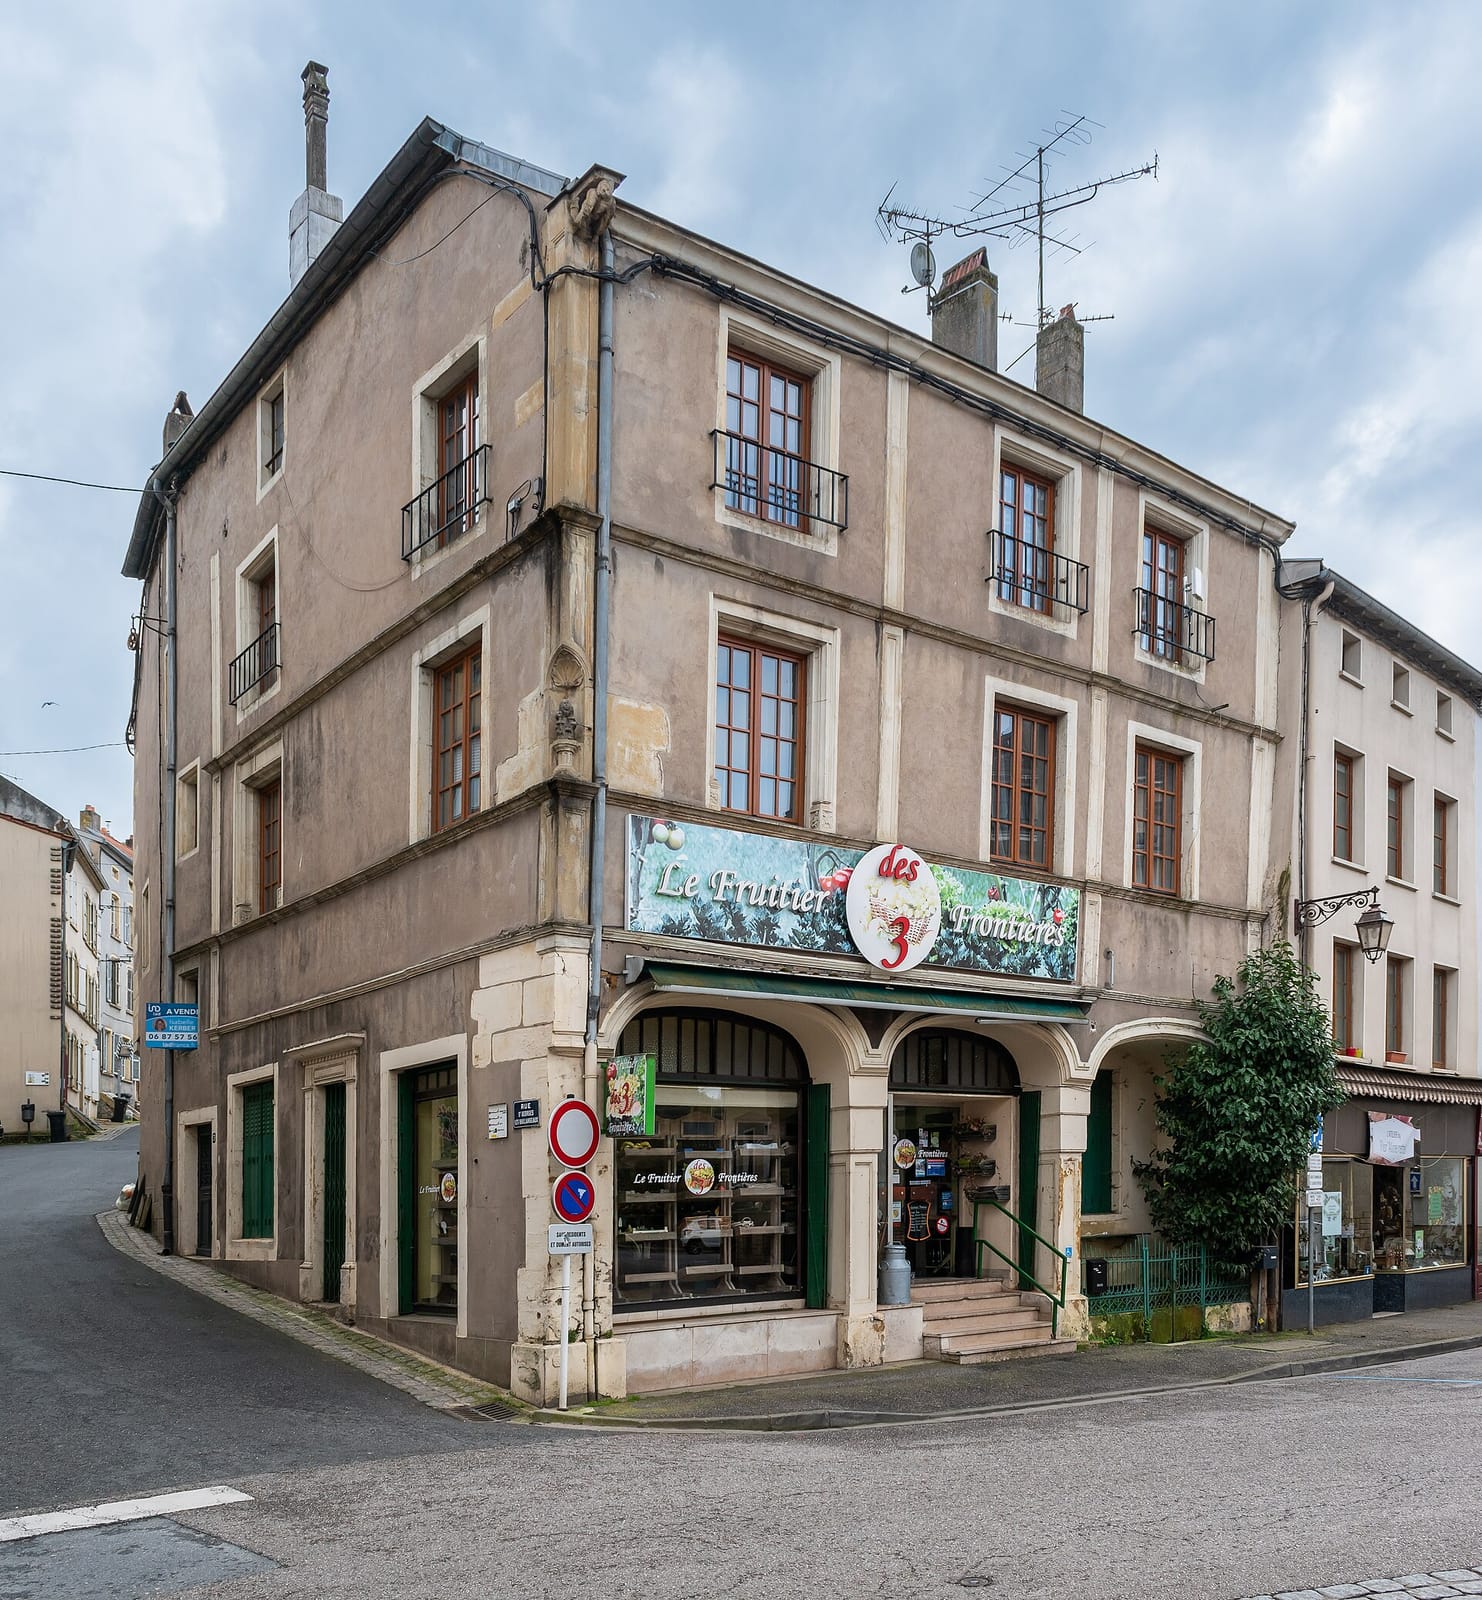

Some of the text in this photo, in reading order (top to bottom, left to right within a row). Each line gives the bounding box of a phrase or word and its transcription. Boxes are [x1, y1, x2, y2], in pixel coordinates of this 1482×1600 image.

[878, 844, 920, 882] des
[657, 861, 831, 913] Le Fruitier
[881, 916, 910, 969] 3
[950, 903, 1065, 947] Frontières
[619, 1082, 630, 1114] 3
[917, 1149, 949, 1158] Frontières
[633, 1172, 682, 1184] Le Fruitier
[718, 1172, 759, 1182] Frontières
